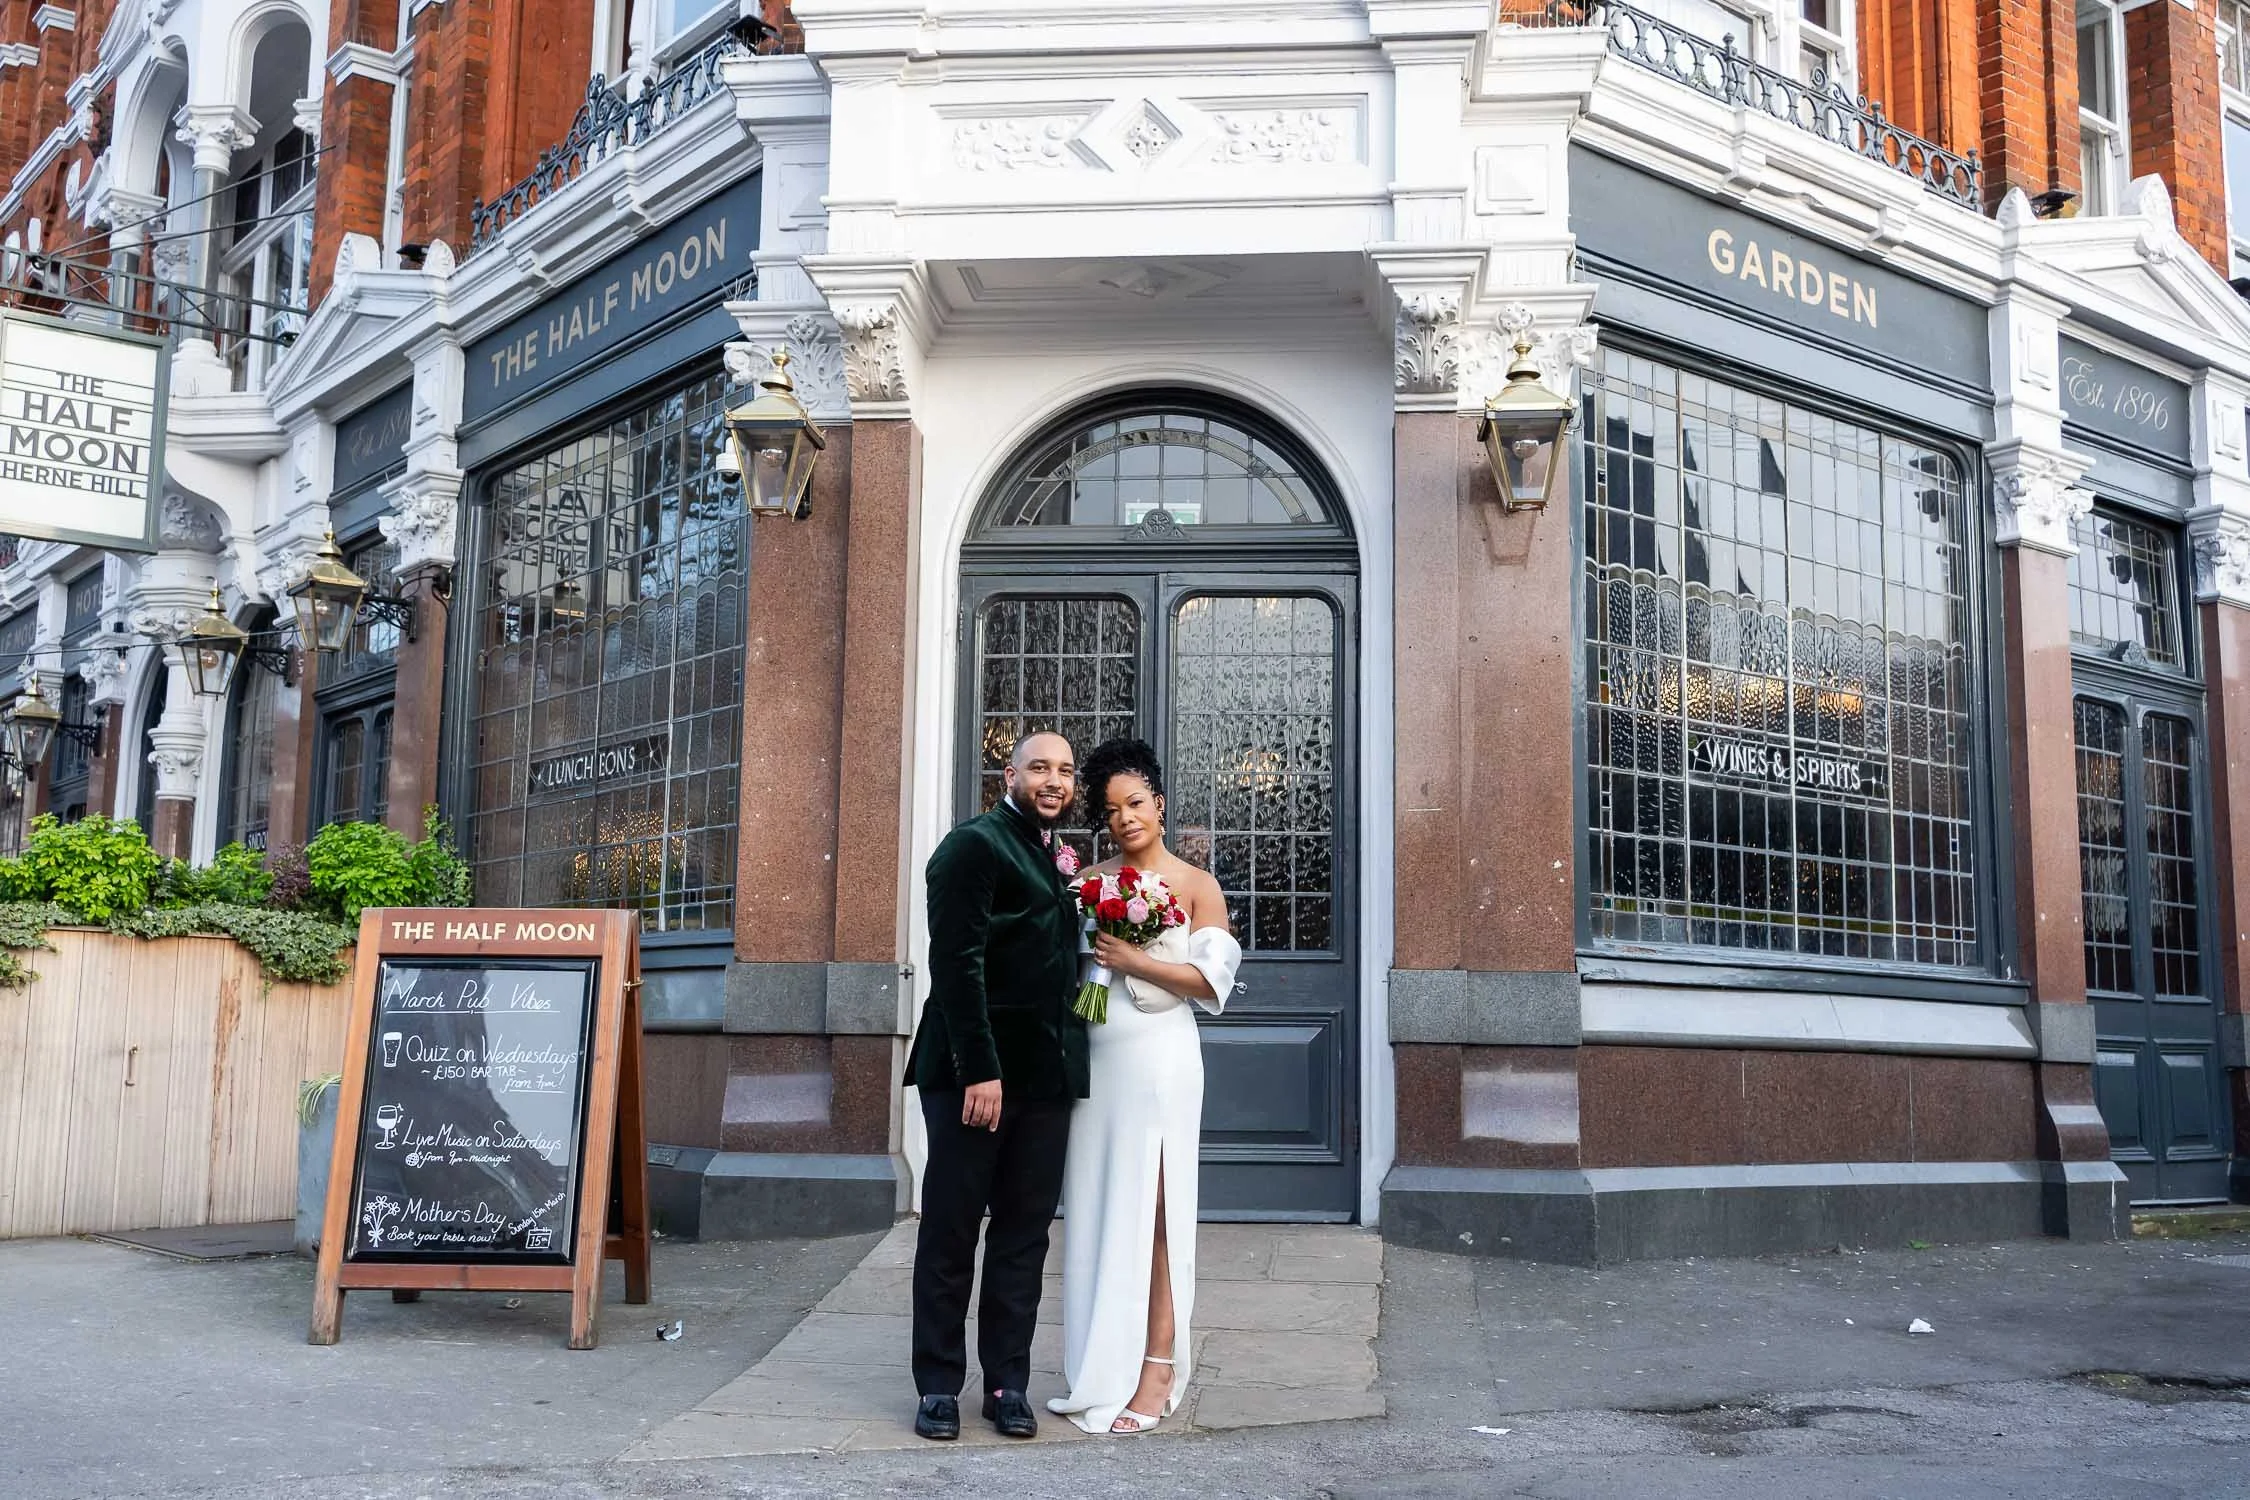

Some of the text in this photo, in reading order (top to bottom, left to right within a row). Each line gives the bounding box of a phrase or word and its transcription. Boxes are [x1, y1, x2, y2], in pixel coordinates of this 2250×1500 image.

[1708, 229, 1877, 328] GARDEN
[491, 217, 726, 388] THE HALF MOON
[56, 371, 104, 397] THE
[2062, 357, 2169, 431] Est. 1896
[23, 391, 133, 434] HALF
[10, 425, 138, 474] MOON
[3, 463, 140, 498] HERNE HILL
[1705, 740, 1861, 790] WINES & SPIRITS
[392, 922, 595, 941] THE HALF MOON
[384, 977, 551, 1010] March Pub Vibes
[406, 1034, 577, 1074] Quiz on Wednesdays
[433, 1065, 465, 1080] £150
[471, 1066, 490, 1078] BAR
[500, 1078, 532, 1093] from
[435, 1123, 472, 1147] Music
[475, 1135, 490, 1147] on
[492, 1120, 561, 1160] Saturdays
[417, 1152, 443, 1168] from
[474, 1201, 507, 1233] Day
[508, 1217, 537, 1235] Sunday
[544, 1192, 566, 1210] March
[387, 1225, 497, 1247] Book your table now!
